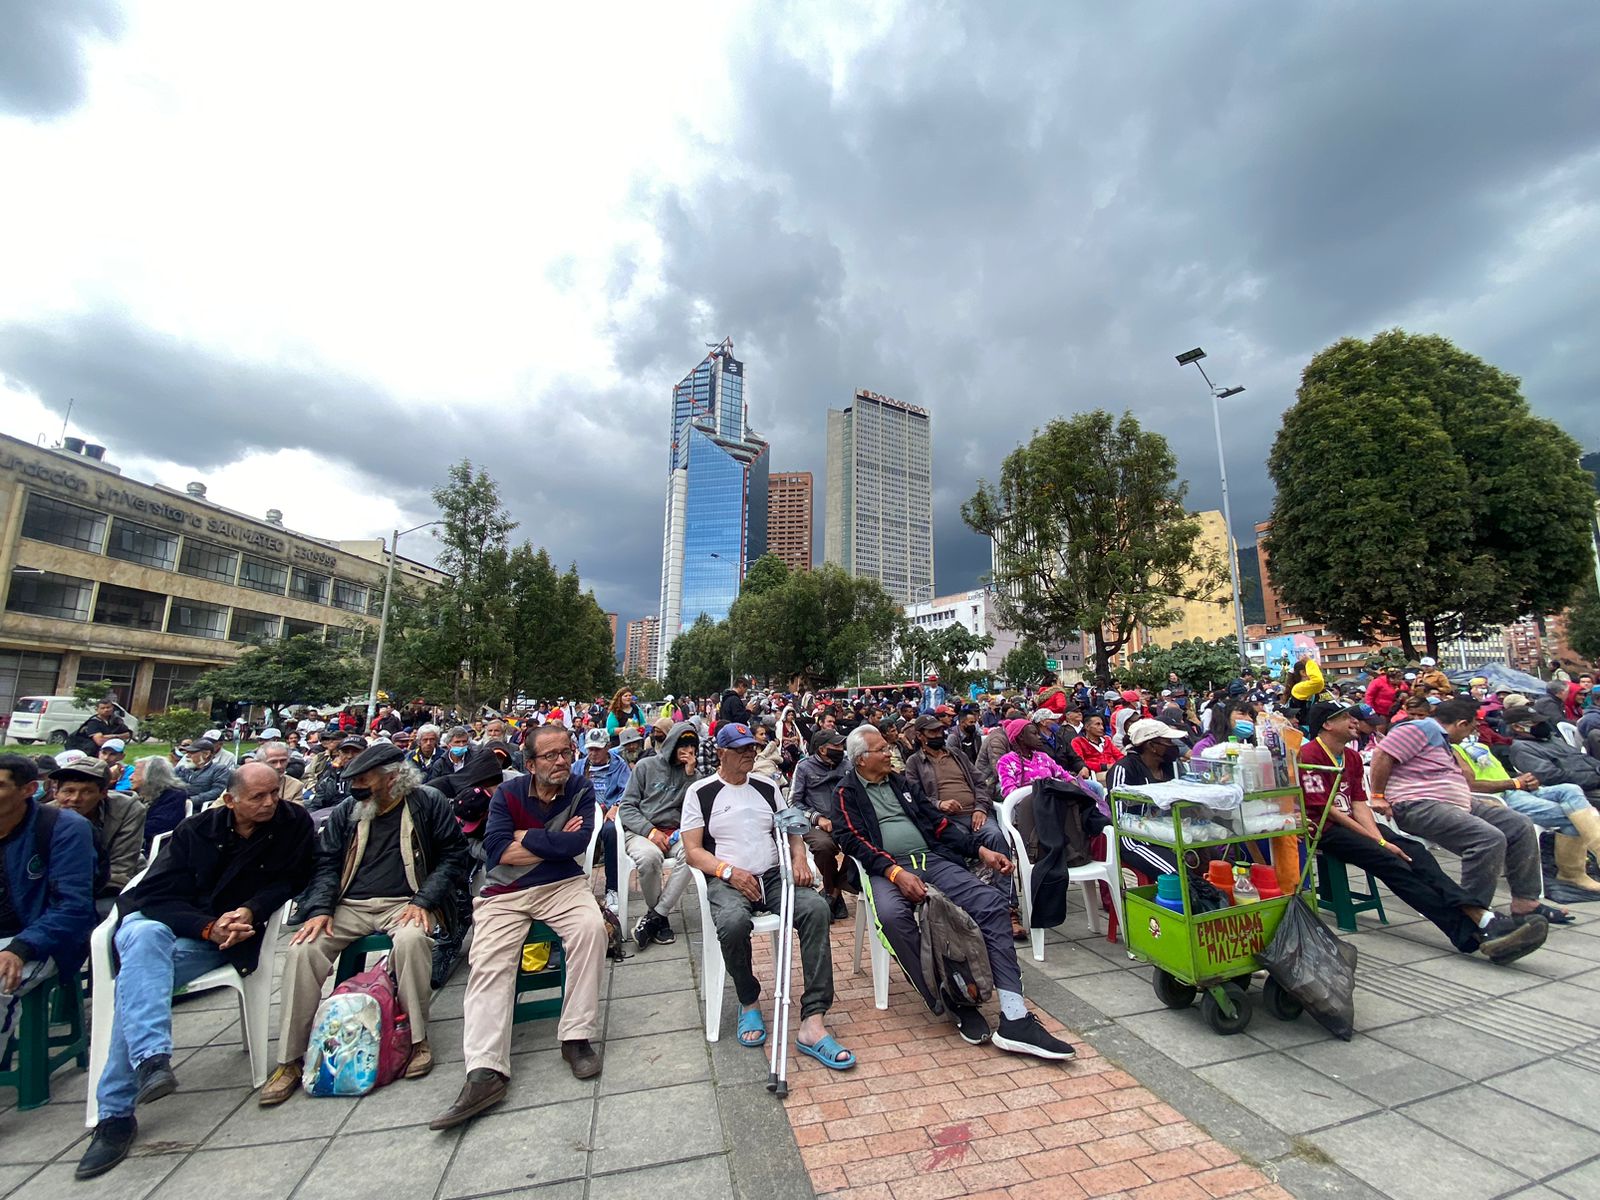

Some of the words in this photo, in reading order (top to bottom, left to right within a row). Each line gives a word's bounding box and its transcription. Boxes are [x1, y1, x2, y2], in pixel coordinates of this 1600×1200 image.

[871, 391, 926, 413] DAVIVIENDA
[0, 452, 88, 494] undación
[207, 519, 240, 539] SAN
[240, 527, 287, 552] MATEO
